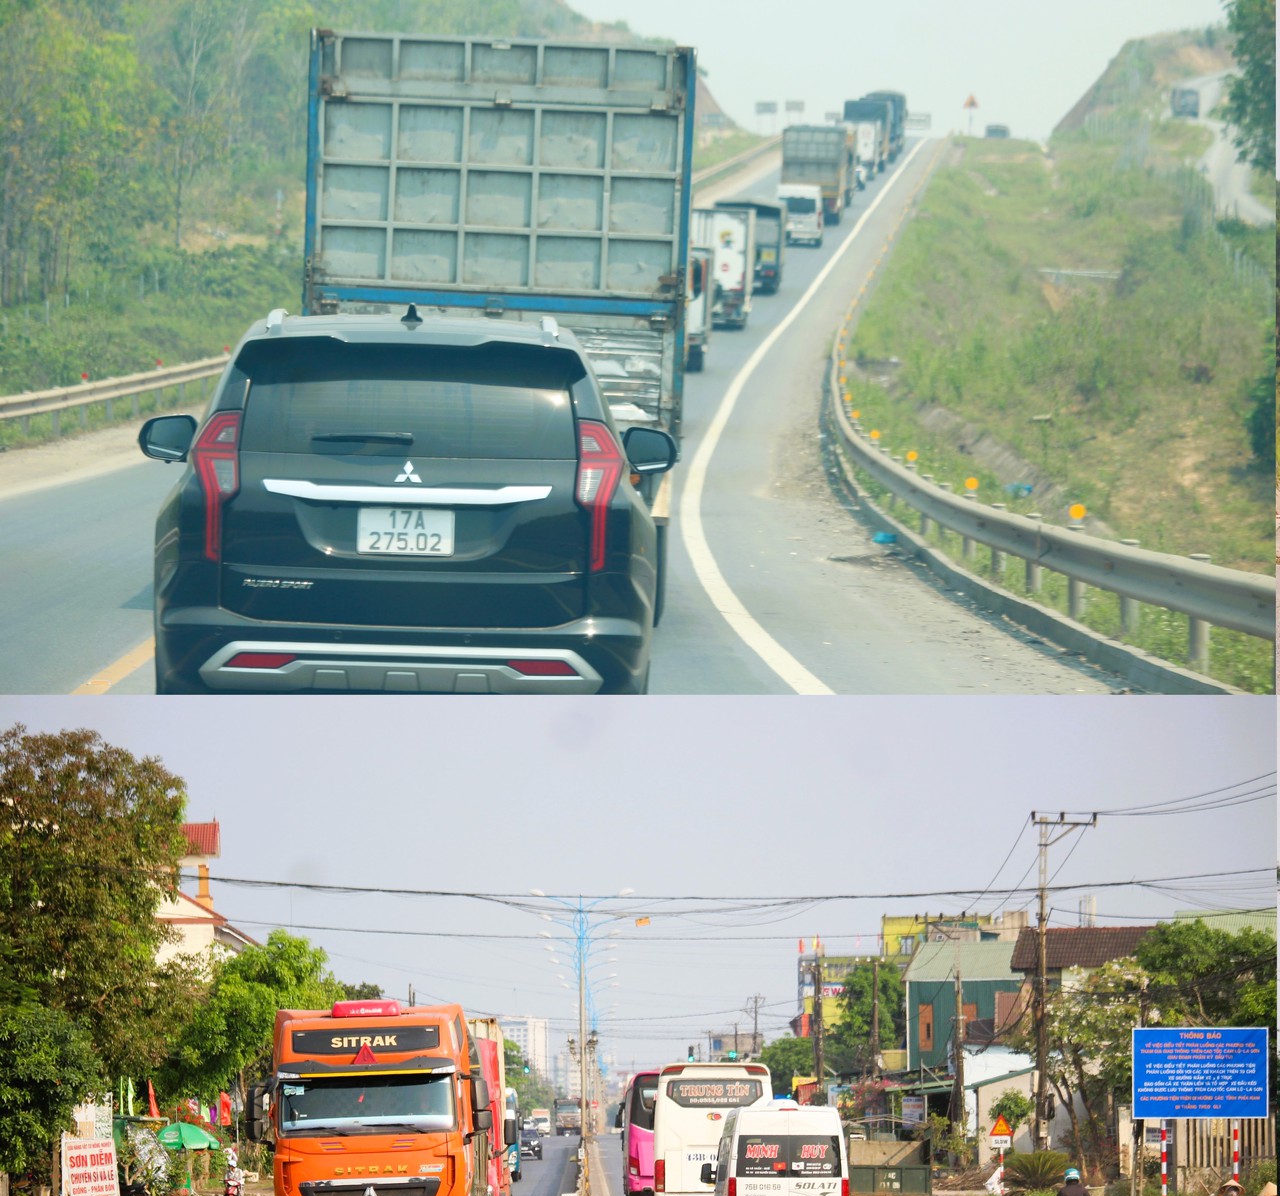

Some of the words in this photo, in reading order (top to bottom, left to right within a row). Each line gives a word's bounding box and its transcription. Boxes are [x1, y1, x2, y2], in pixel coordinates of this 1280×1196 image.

[389, 511, 424, 529] 17A
[369, 532, 442, 551] 275.02
[331, 1035, 397, 1048] SITRAK
[680, 1085, 724, 1097] TRUNG
[726, 1081, 750, 1096] TÍN
[745, 1143, 779, 1158] MINH
[801, 1143, 828, 1158] HUY
[69, 1155, 88, 1169] SƠN
[71, 1170, 92, 1184] CHUYÊN
[334, 1165, 408, 1175] SITRAK
